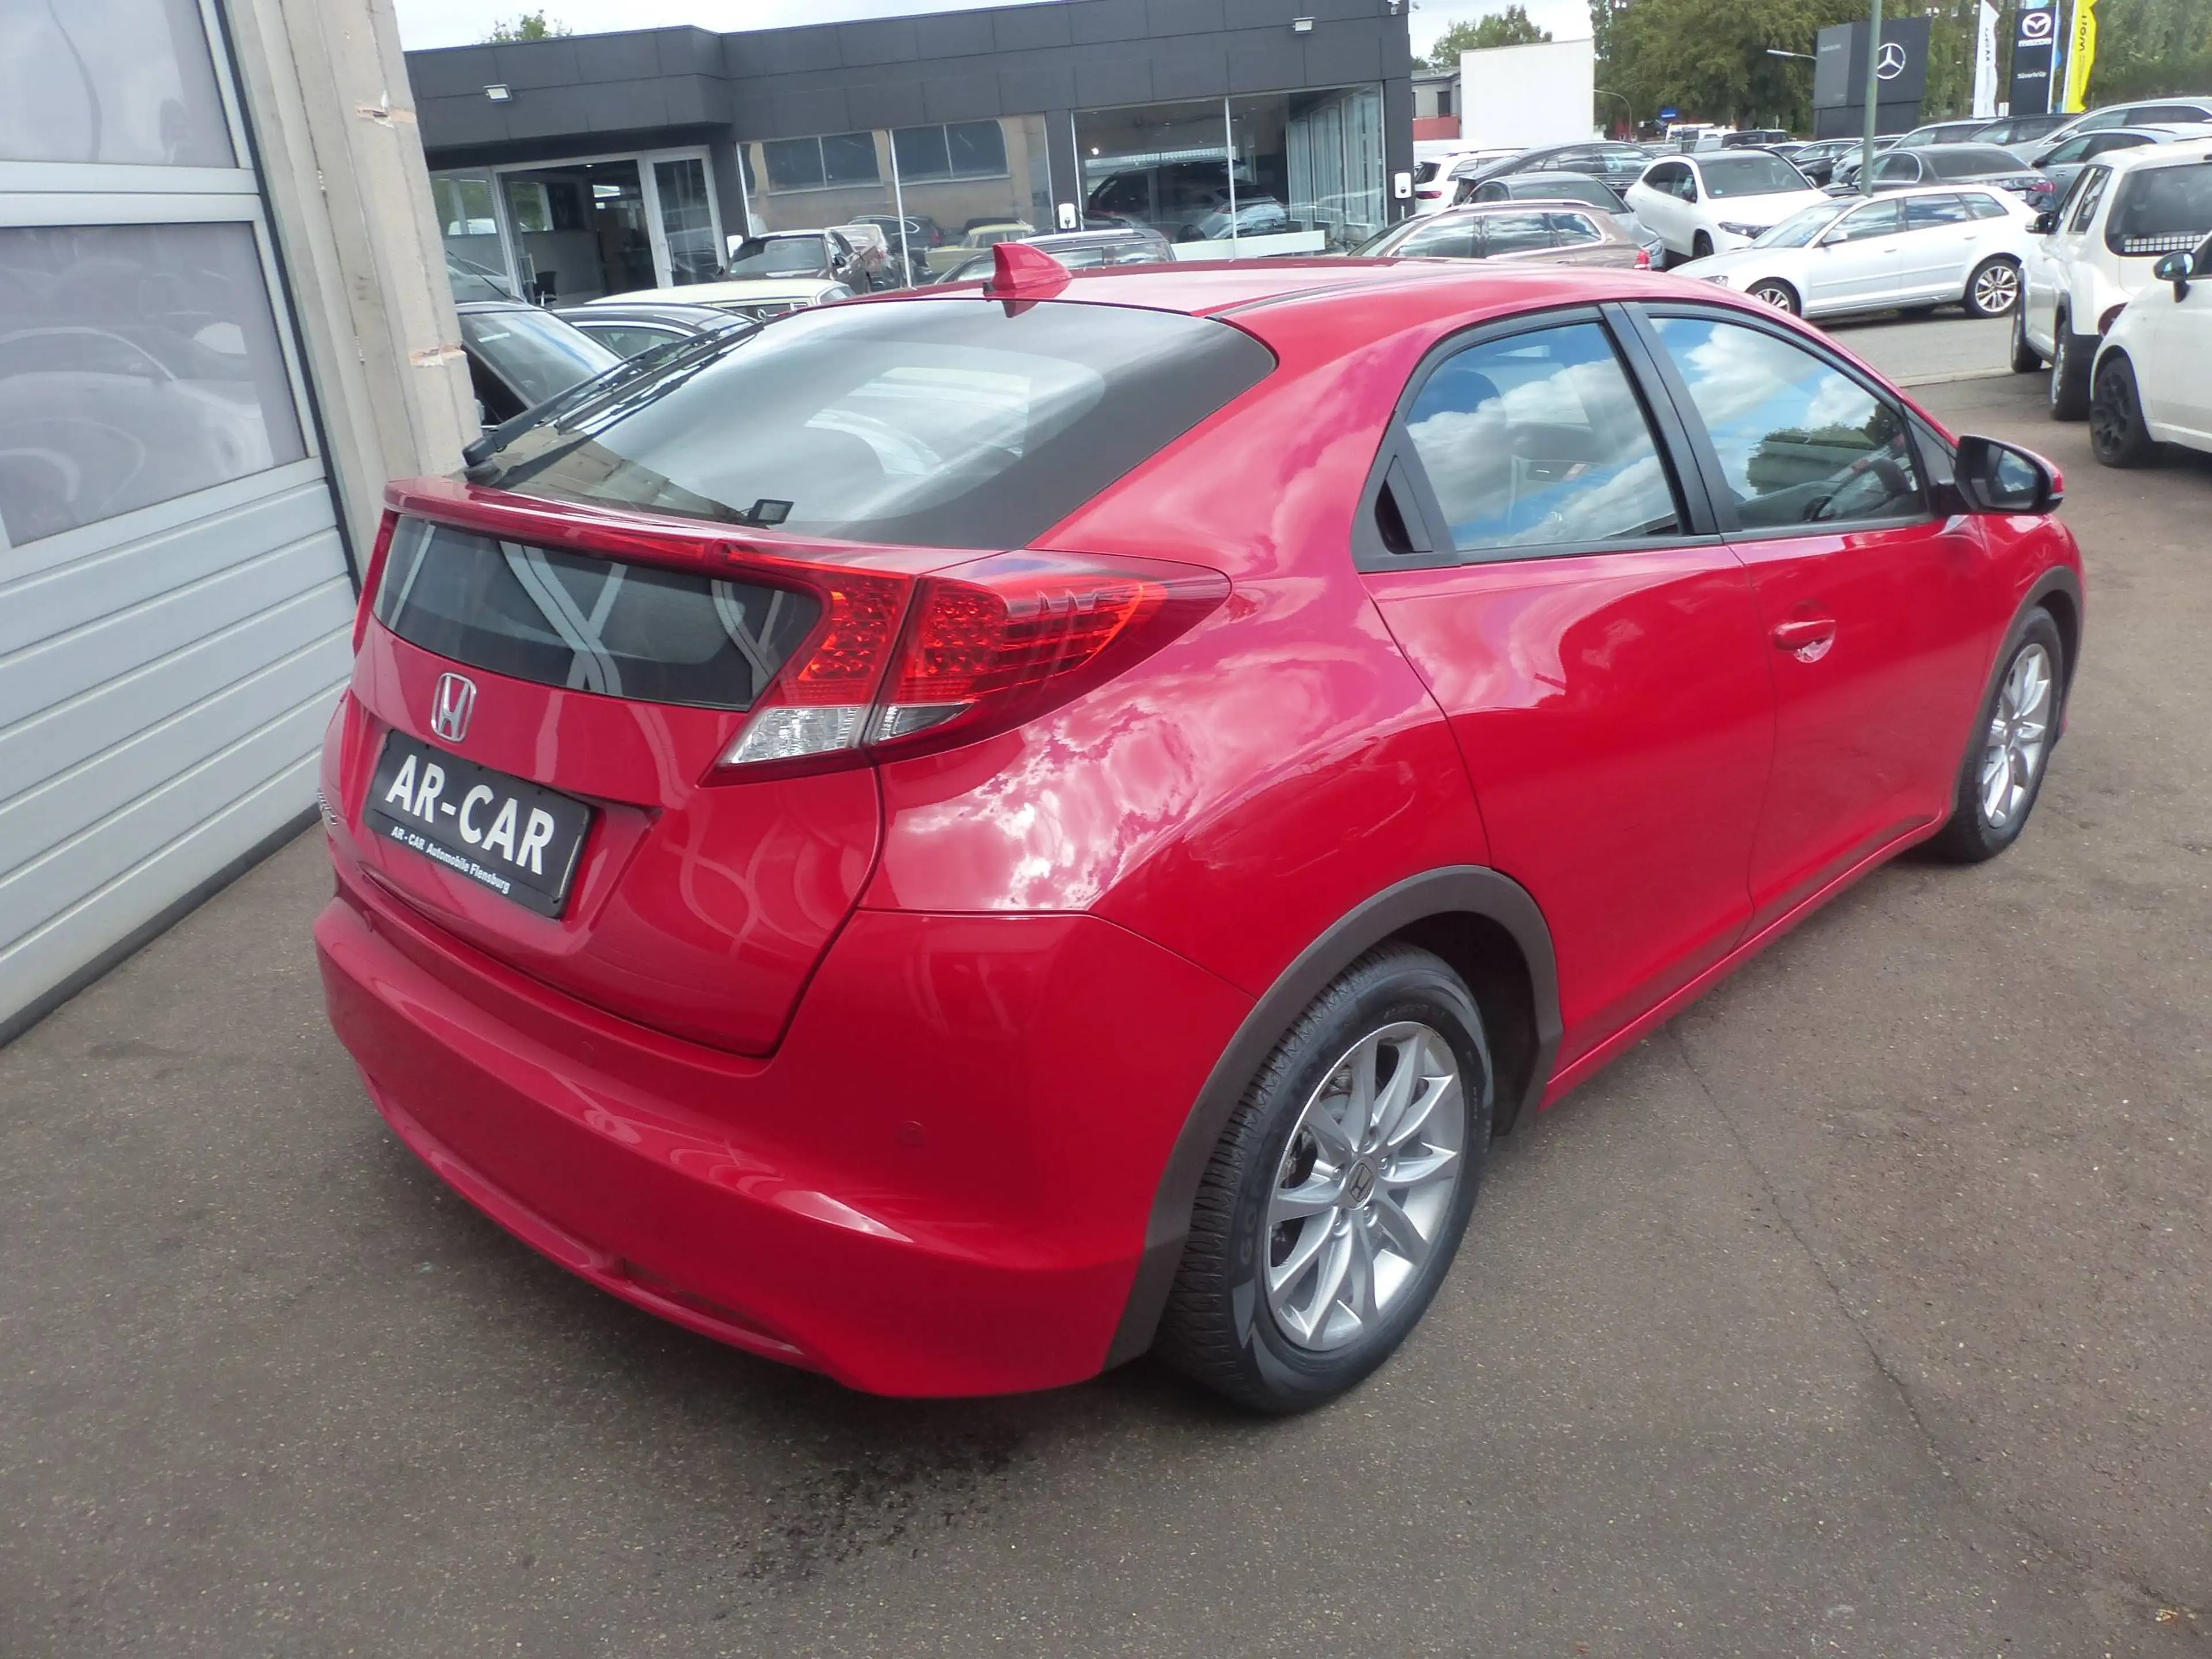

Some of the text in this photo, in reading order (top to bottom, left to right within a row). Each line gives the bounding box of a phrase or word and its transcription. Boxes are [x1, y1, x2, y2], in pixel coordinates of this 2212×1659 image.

[384, 754, 554, 875] AR-CAR
[426, 843, 471, 872] Automobile
[469, 863, 510, 895] Flensburg
